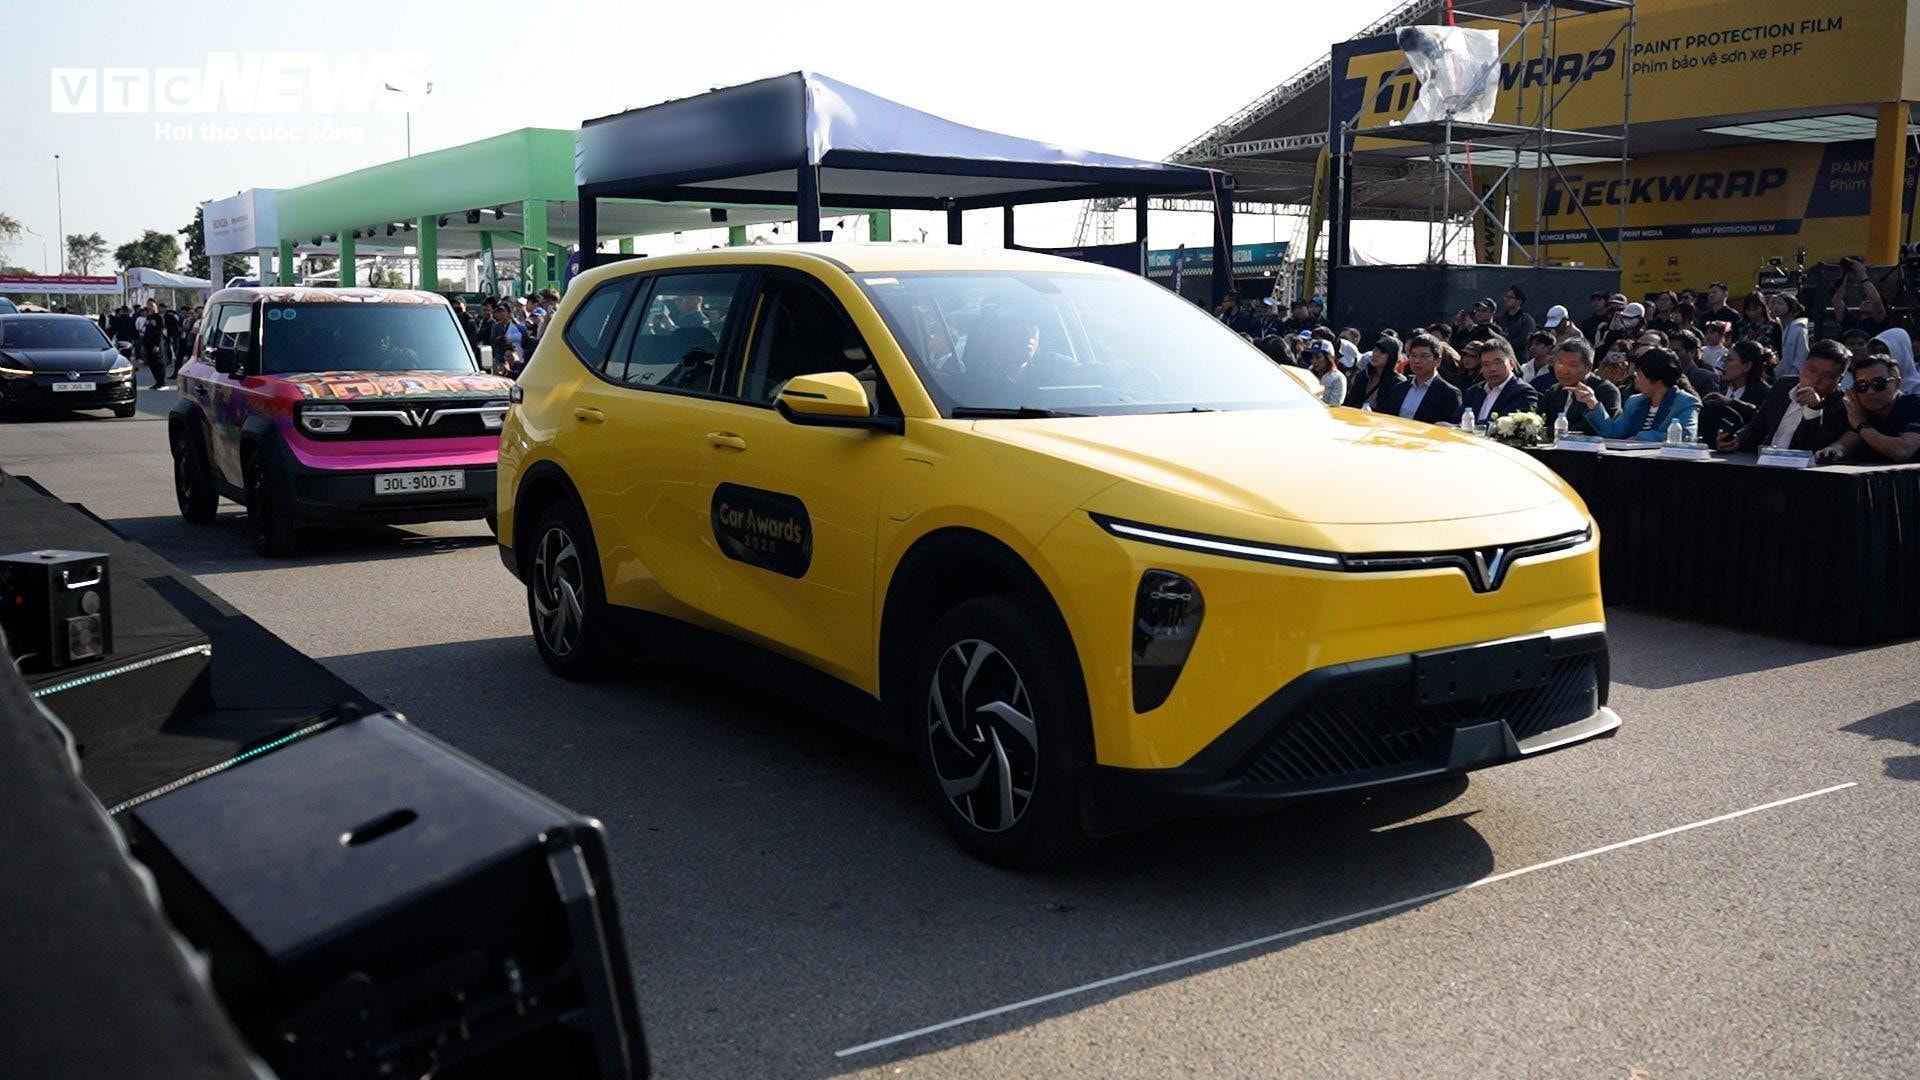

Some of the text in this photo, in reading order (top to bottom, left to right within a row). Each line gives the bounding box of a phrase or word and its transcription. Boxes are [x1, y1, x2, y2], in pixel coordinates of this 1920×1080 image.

[1634, 16, 1843, 57] PAINT PROTECTION FILM
[1632, 41, 1804, 76] Phim bảo vệ sơn xe PPF
[1831, 160, 1874, 174] PAIN
[1566, 232, 1588, 241] WRAPS
[1642, 229, 1663, 237] MEDIA
[1691, 223, 1776, 236] PAINT PROTECTION FILM
[383, 475, 457, 491] 30L-900.76
[720, 502, 802, 544] Car Awards
[744, 534, 776, 554] 2025
